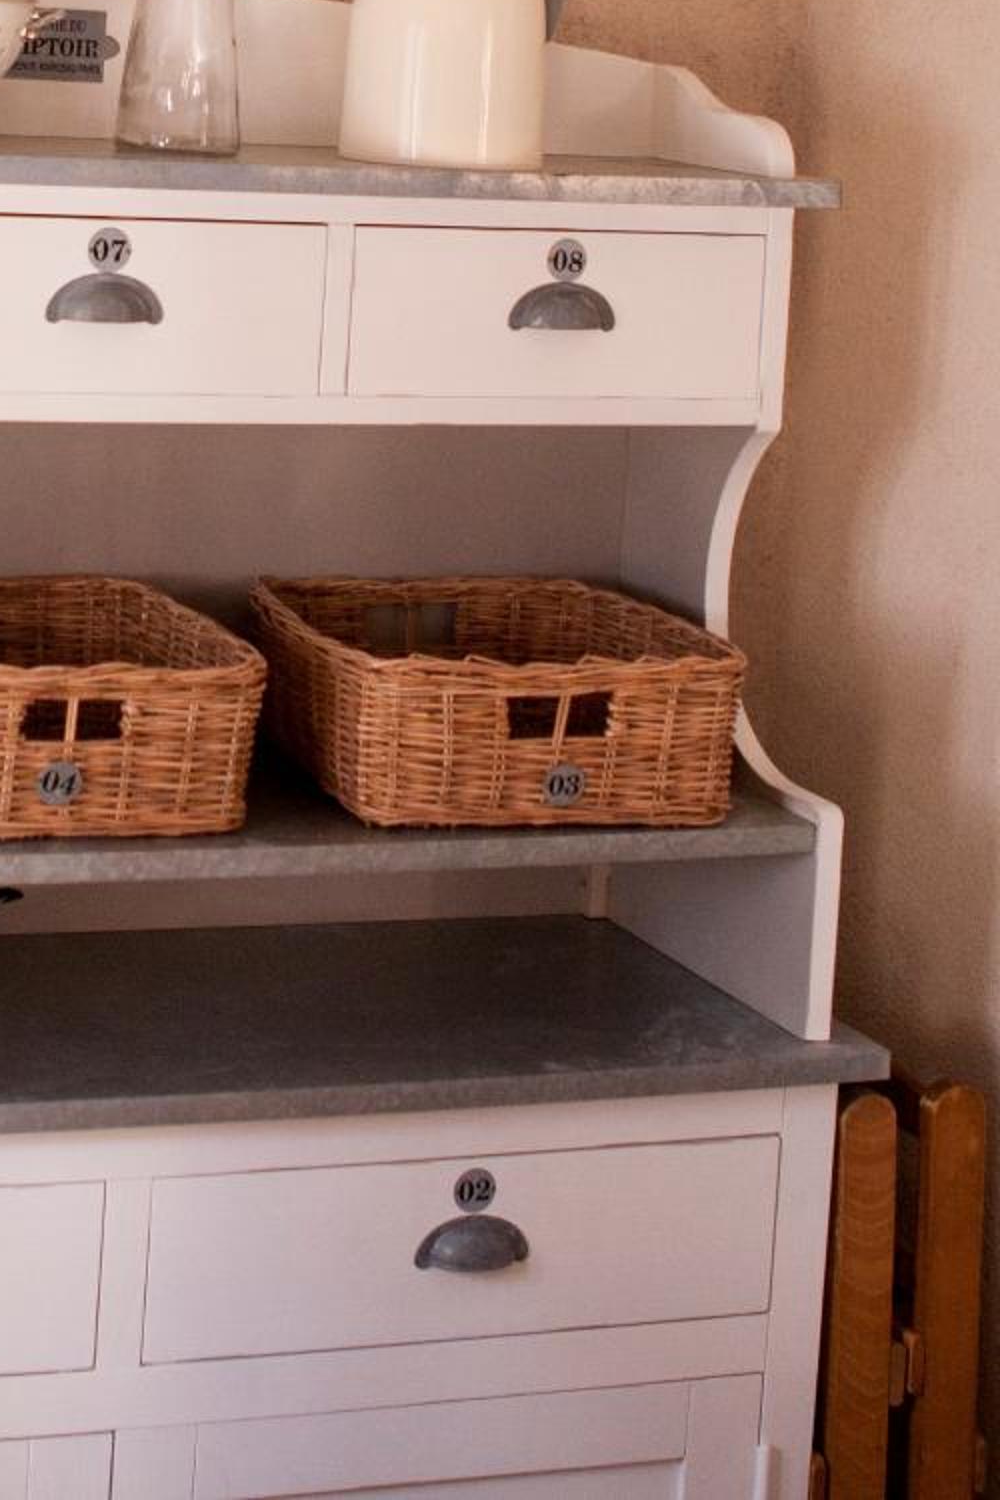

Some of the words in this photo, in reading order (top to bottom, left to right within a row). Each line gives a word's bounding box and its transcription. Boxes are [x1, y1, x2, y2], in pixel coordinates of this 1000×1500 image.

[93, 237, 128, 263] 07
[552, 248, 584, 273] 08
[41, 770, 77, 796] 04
[549, 774, 580, 796] 03
[459, 1180, 491, 1202] 02
